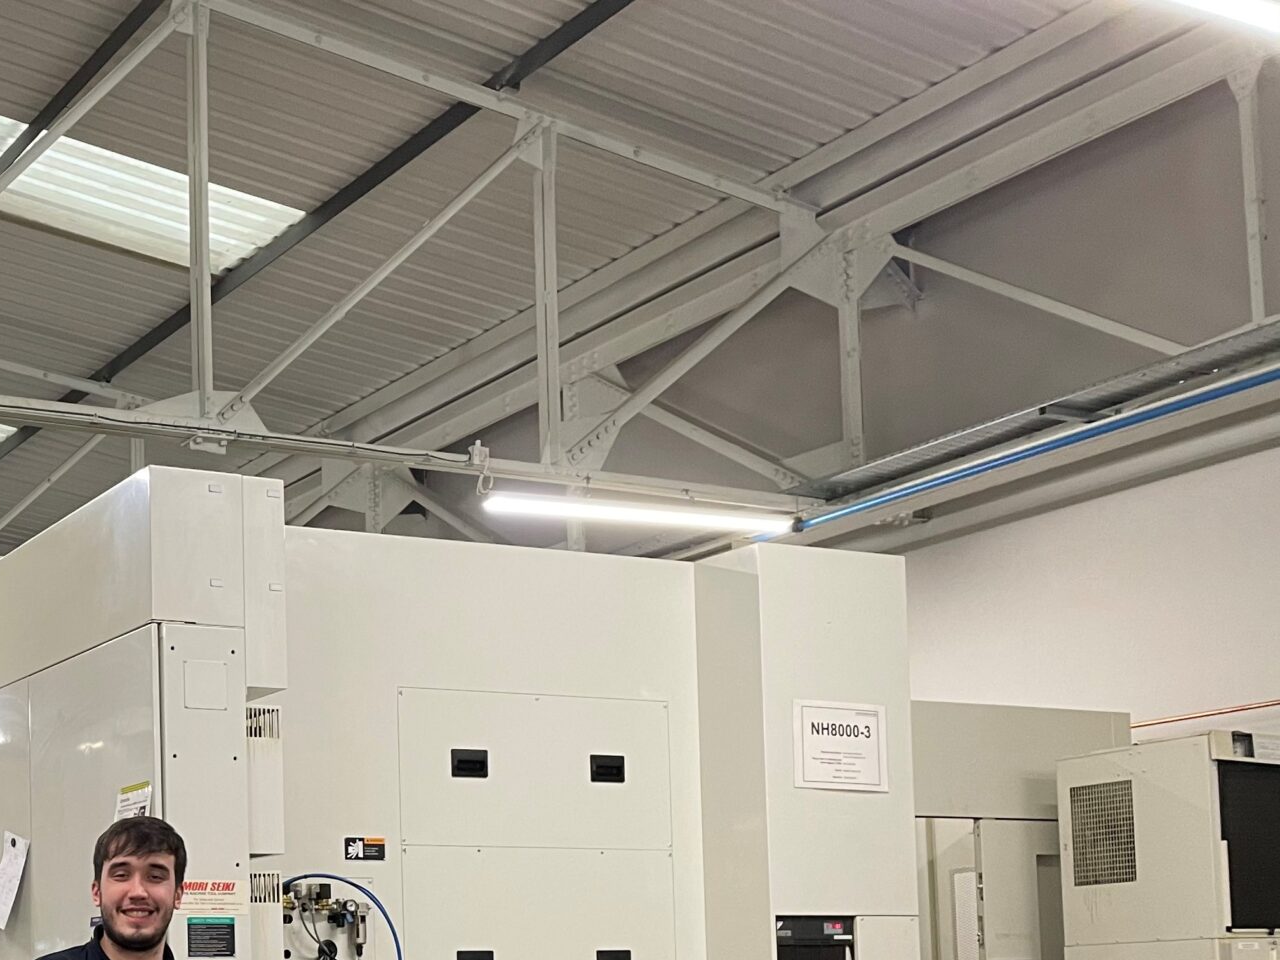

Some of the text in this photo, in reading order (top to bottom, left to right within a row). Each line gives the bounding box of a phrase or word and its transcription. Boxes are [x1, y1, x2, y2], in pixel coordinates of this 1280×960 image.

[810, 721, 871, 739] NH8000-3
[183, 881, 236, 892] MORI SEIKI
